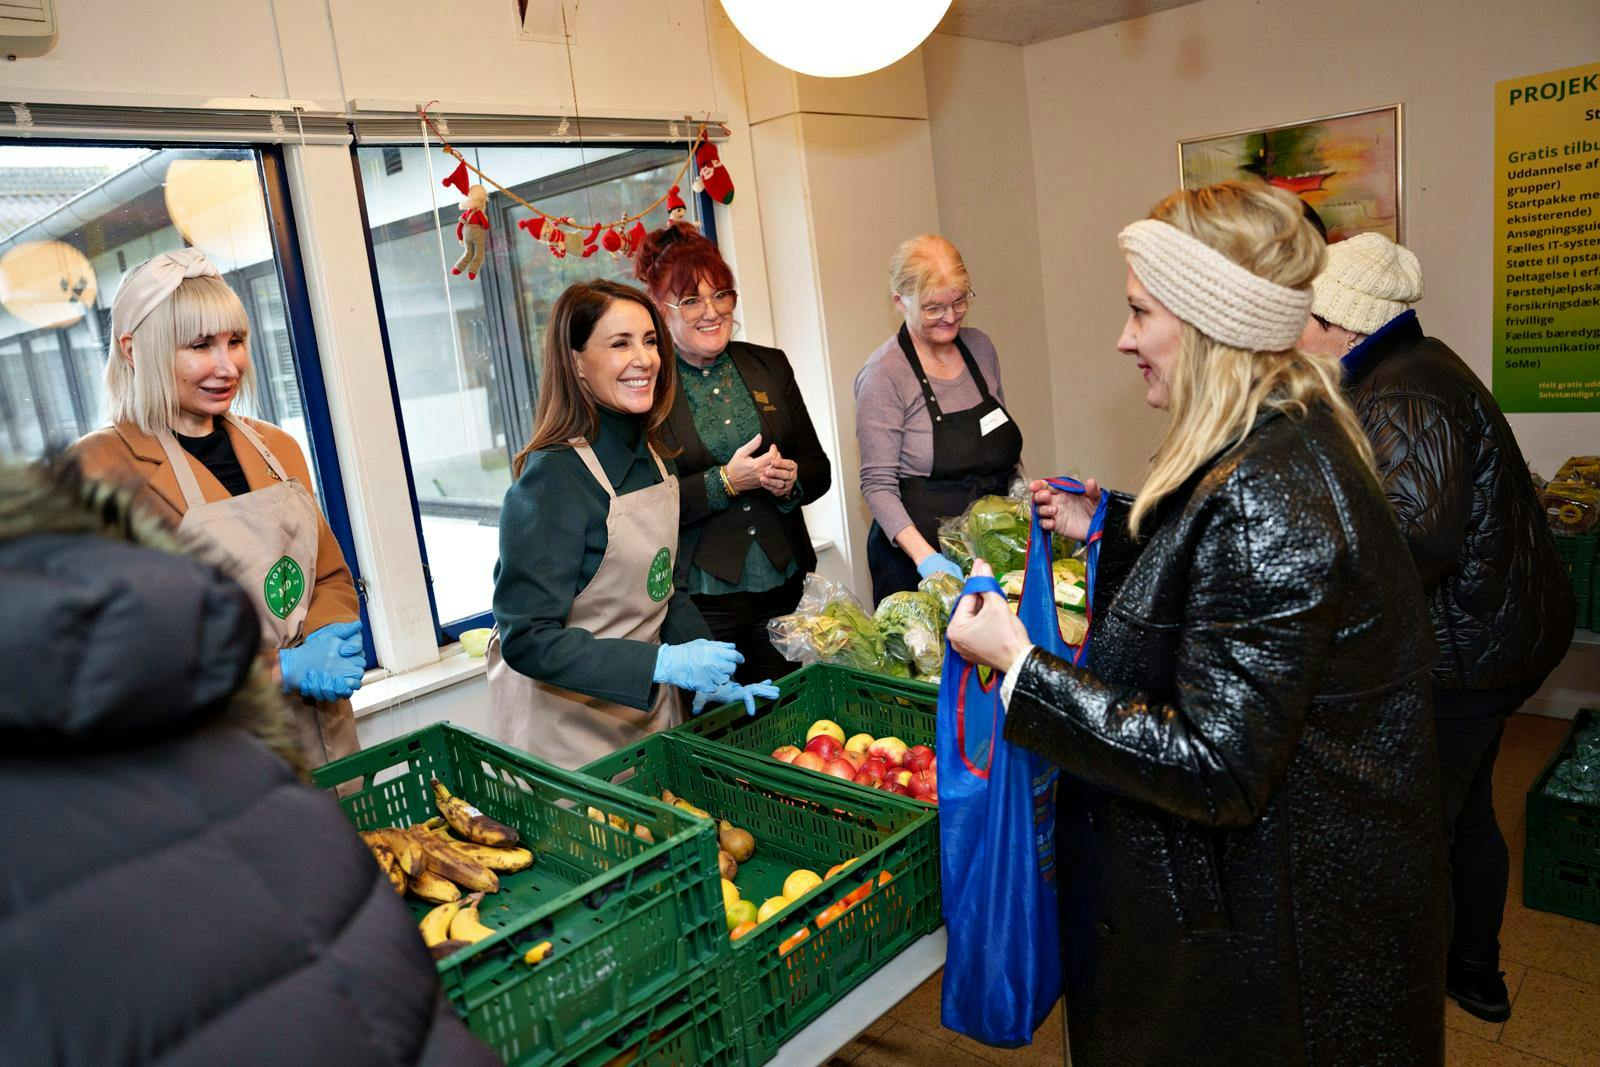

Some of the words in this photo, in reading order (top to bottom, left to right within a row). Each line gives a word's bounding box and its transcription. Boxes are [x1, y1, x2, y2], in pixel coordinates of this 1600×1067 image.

[1510, 73, 1600, 106] PROJEK
[1508, 146, 1558, 163] Gratis
[1508, 163, 1582, 180] Uddannelse
[1585, 158, 1599, 170] af
[1507, 180, 1561, 197] grupper)
[1507, 194, 1576, 210] Startpakke
[1507, 207, 1592, 225] eksisterende)
[1507, 243, 1545, 254] Fælles
[1506, 257, 1543, 269] Støtte
[1546, 255, 1559, 265] til
[1563, 253, 1600, 265] opsta
[1506, 270, 1570, 283] Deltagelse
[1573, 268, 1577, 278] i
[1580, 266, 1600, 277] erf
[1506, 282, 1600, 297] Førstehjælpska
[1506, 297, 1600, 312] Forsikringsdæk
[1506, 315, 1554, 326] frivillige
[1506, 330, 1543, 341] Fælles
[1505, 359, 1541, 370] SoMe)
[1539, 381, 1556, 389] Helt
[1558, 381, 1583, 390] gratis
[1539, 390, 1594, 399] Selvstændige
